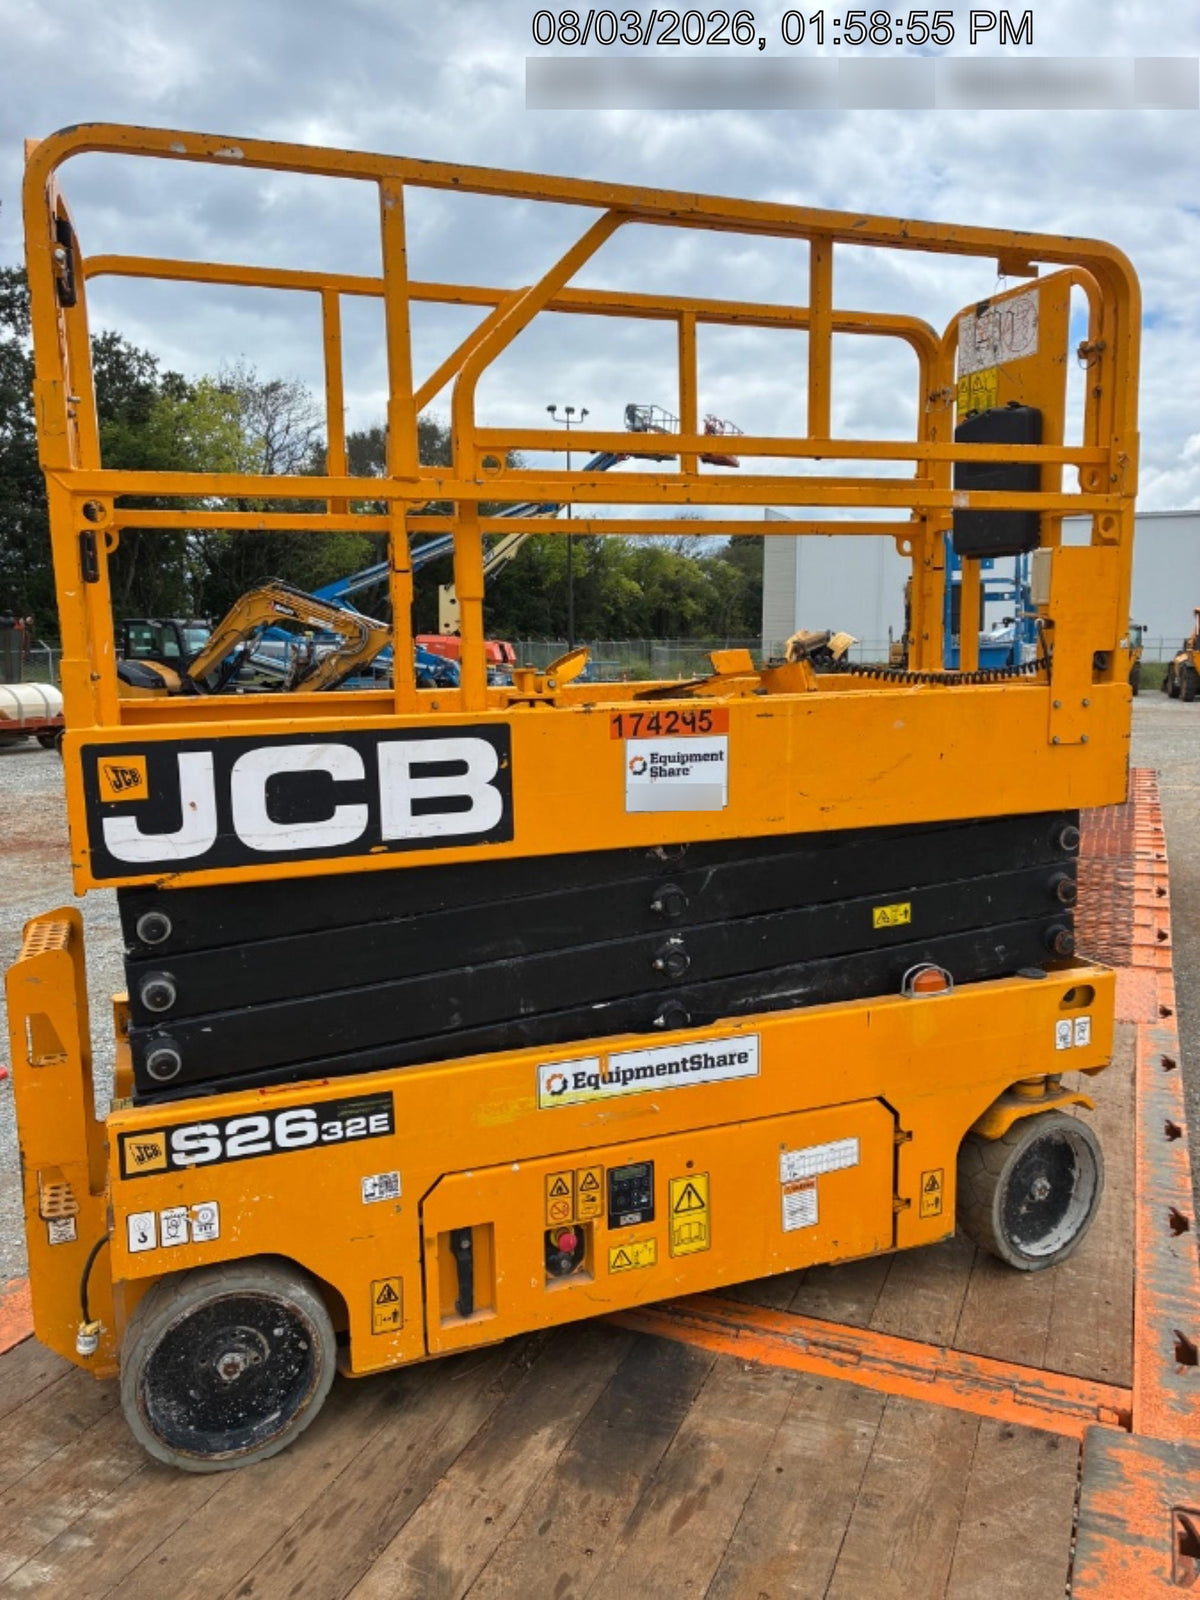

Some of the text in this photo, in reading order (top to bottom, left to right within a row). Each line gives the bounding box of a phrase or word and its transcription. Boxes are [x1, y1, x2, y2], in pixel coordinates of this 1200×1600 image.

[650, 750, 724, 766] Equipment
[109, 767, 140, 790] JCB
[650, 765, 691, 778] Share
[102, 737, 503, 863] JCB
[572, 1051, 749, 1090] EquipmentShare
